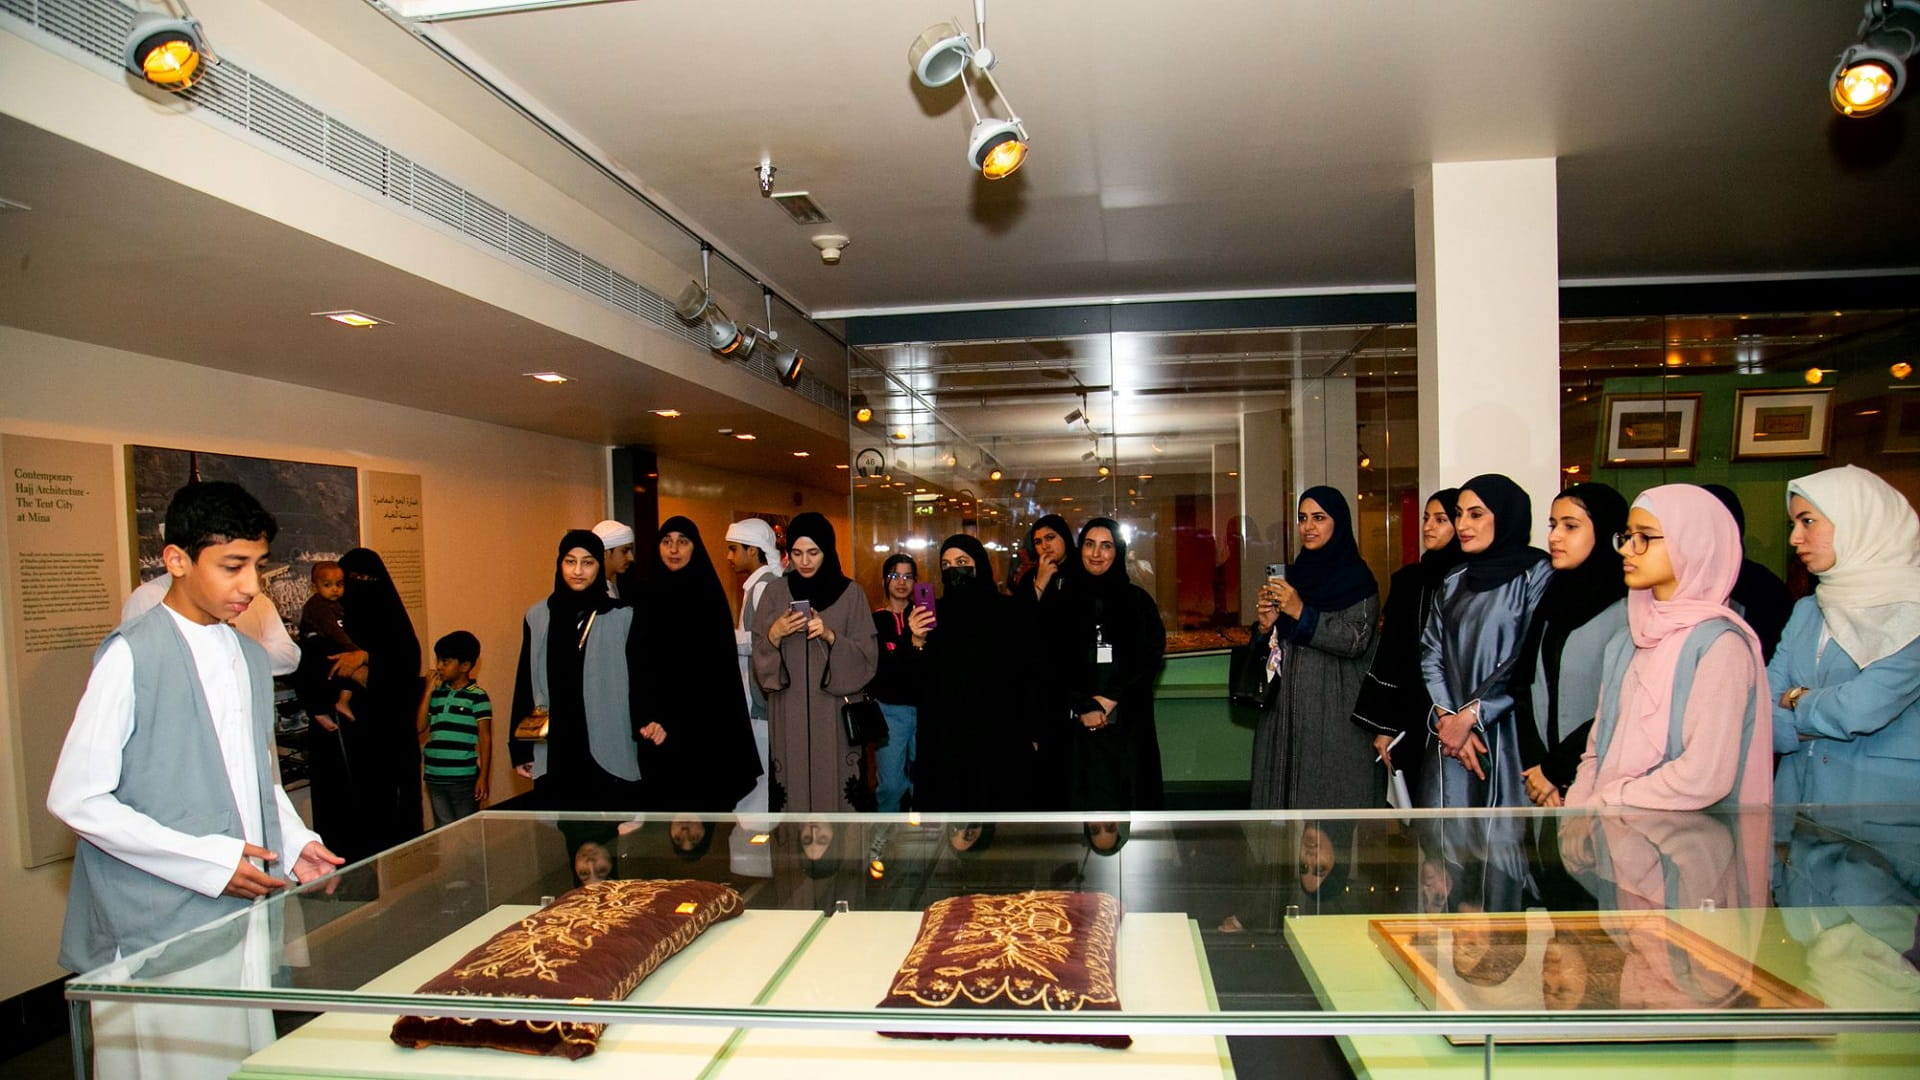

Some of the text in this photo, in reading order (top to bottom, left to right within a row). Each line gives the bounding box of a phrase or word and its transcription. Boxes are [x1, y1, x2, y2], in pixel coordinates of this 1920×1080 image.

[14, 468, 73, 484] Contemporary
[15, 483, 34, 496] Hajj
[36, 485, 84, 496] Architecture
[15, 497, 73, 512] The Tent City
[17, 512, 51, 522] at Mina
